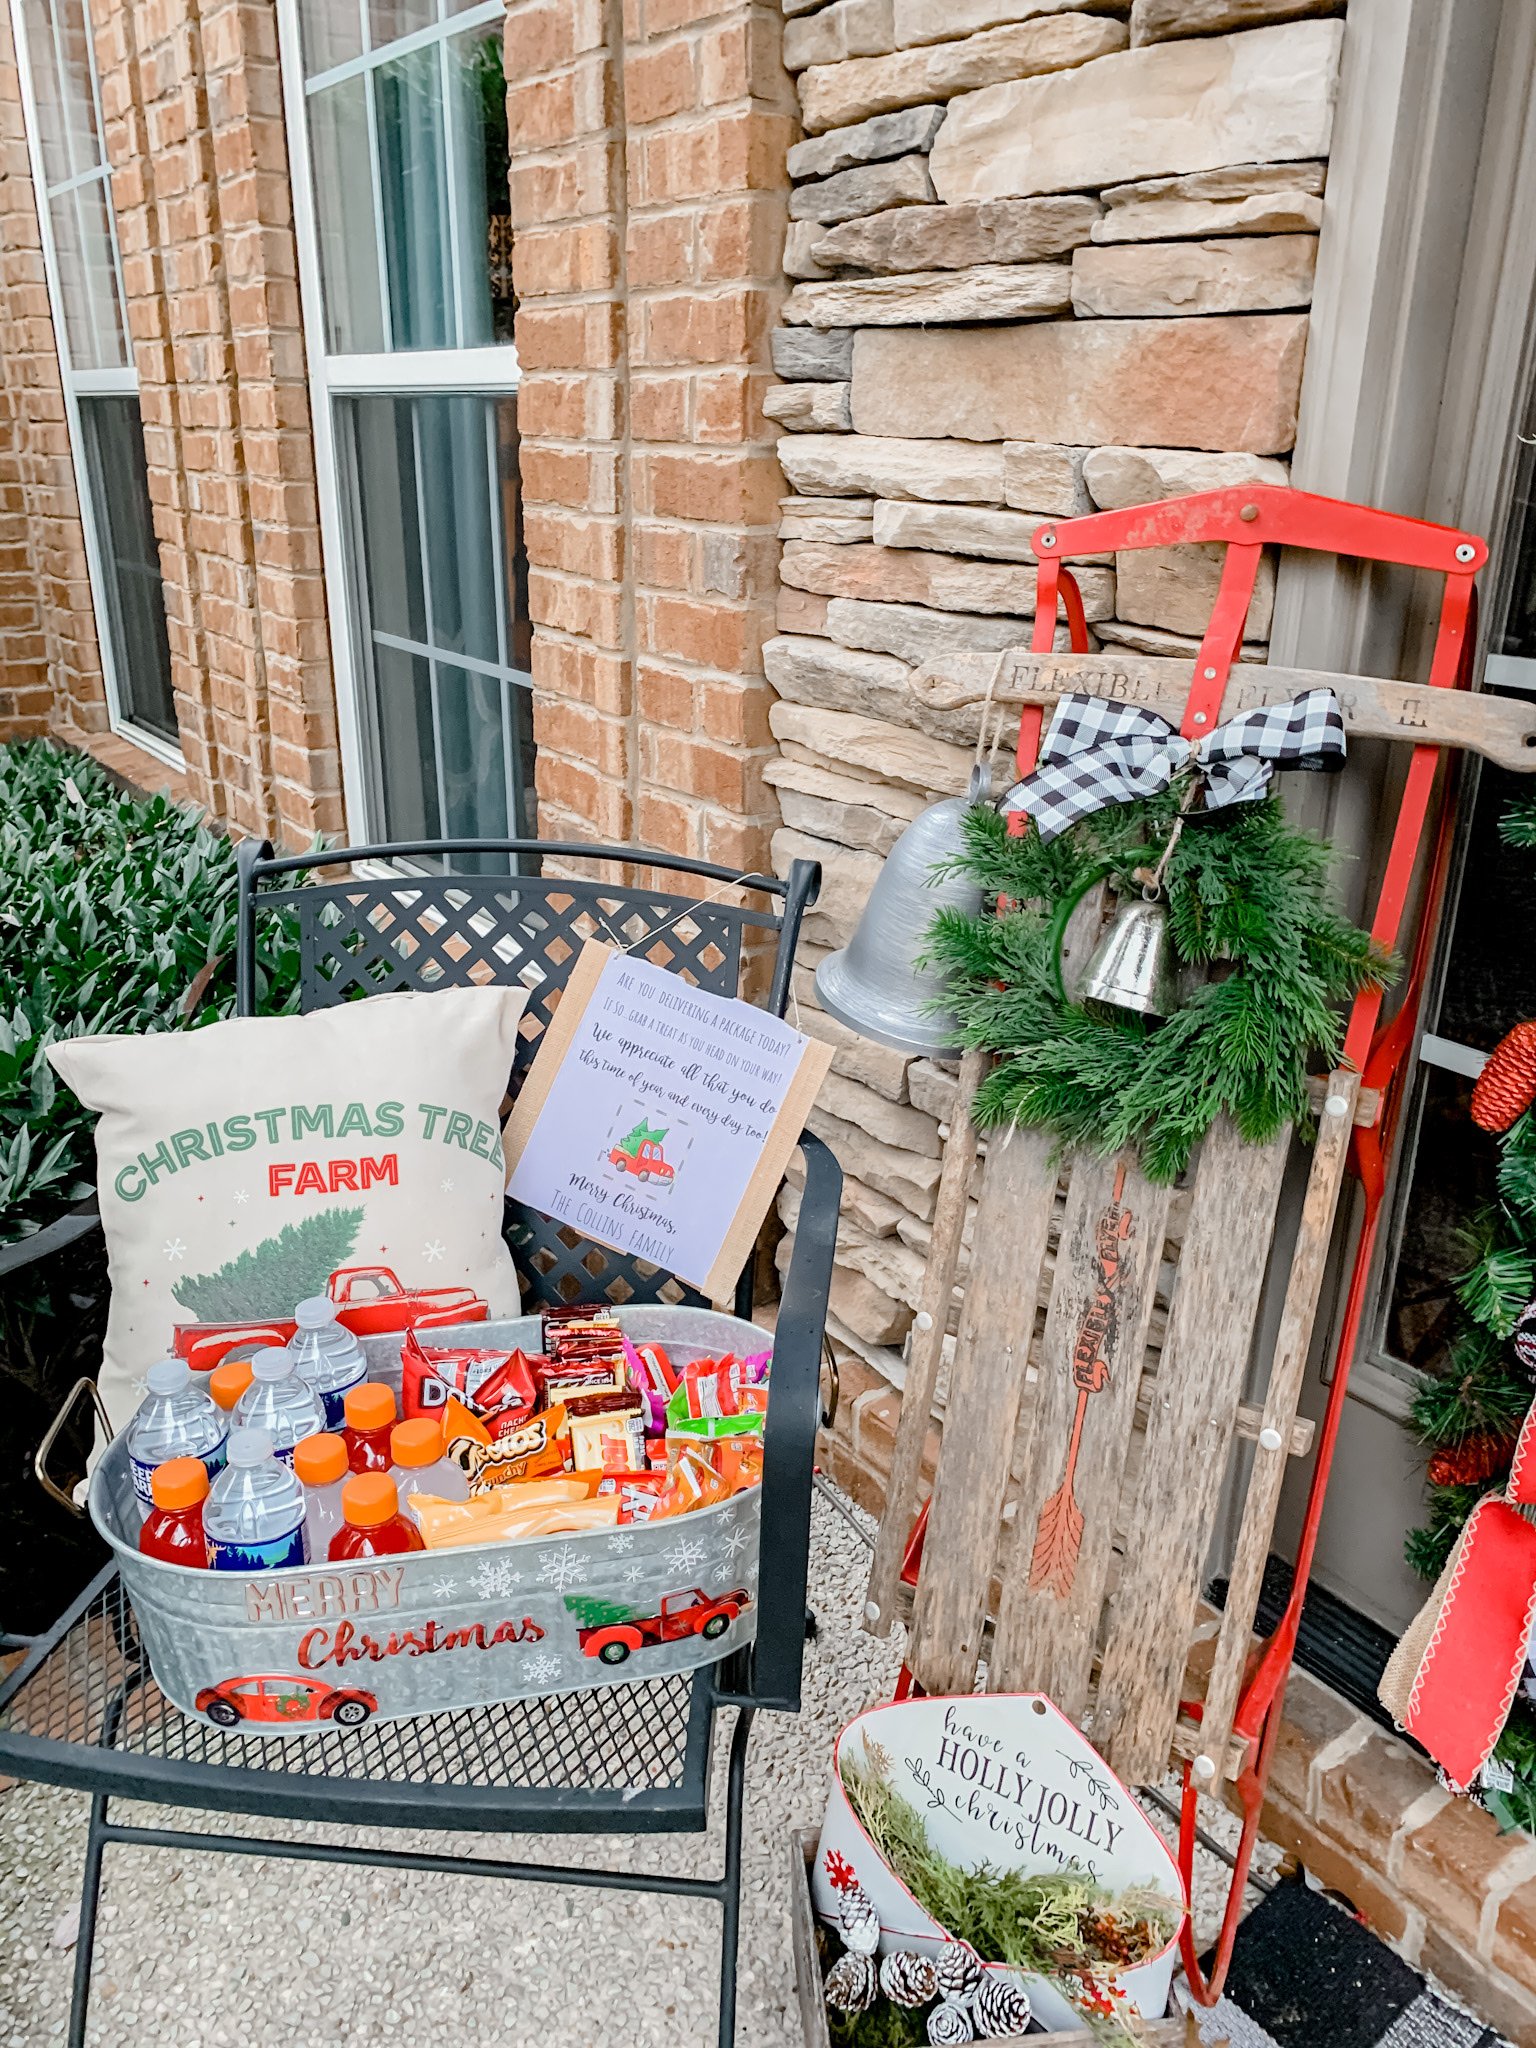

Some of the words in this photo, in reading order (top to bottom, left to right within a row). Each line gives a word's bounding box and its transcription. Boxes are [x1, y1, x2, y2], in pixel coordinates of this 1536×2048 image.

[603, 996, 612, 1011] IF
[647, 1018, 655, 1030] A
[655, 1020, 679, 1041] TREAT
[677, 1031, 688, 1046] AS
[690, 1035, 706, 1052] YOU
[704, 1041, 725, 1061] HEAD
[725, 1051, 740, 1068] ON
[739, 1057, 762, 1078] YOUR
[761, 1067, 784, 1085] WAY!
[617, 972, 635, 991] ARE
[638, 978, 657, 999] YOU
[658, 991, 711, 1024] DELIVERING
[711, 1014, 719, 1027] A
[719, 1017, 757, 1044] PACKAGE
[758, 1033, 792, 1058] TODAY?
[578, 1049, 602, 1070] this
[601, 1059, 626, 1079] time
[628, 1071, 644, 1088] of
[639, 1078, 667, 1098] year
[667, 1091, 690, 1108] and
[690, 1101, 720, 1125] every
[720, 1114, 744, 1136] day
[744, 1123, 769, 1143] too!
[592, 1022, 613, 1042] We
[617, 1036, 676, 1070] appreciate
[680, 1062, 703, 1081] all
[702, 1072, 729, 1094] that
[728, 1088, 757, 1108] you
[759, 1096, 778, 1114] do
[114, 1100, 405, 1202] CHRISTMAS
[268, 1153, 400, 1197] FARM
[550, 1188, 573, 1215] THE
[576, 1202, 625, 1240] COLLINS
[628, 1229, 675, 1264] FAMILY
[568, 1172, 612, 1204] Merry
[612, 1193, 677, 1235] Christmas,
[244, 1566, 406, 1622] MERRY
[297, 1616, 546, 1671] Christmas
[943, 1705, 1005, 1754] have
[1016, 1751, 1032, 1768] a
[936, 1736, 1033, 1807] HOLLY
[1027, 1783, 1125, 1856] JOLLY
[955, 1786, 1105, 1884] christmas
